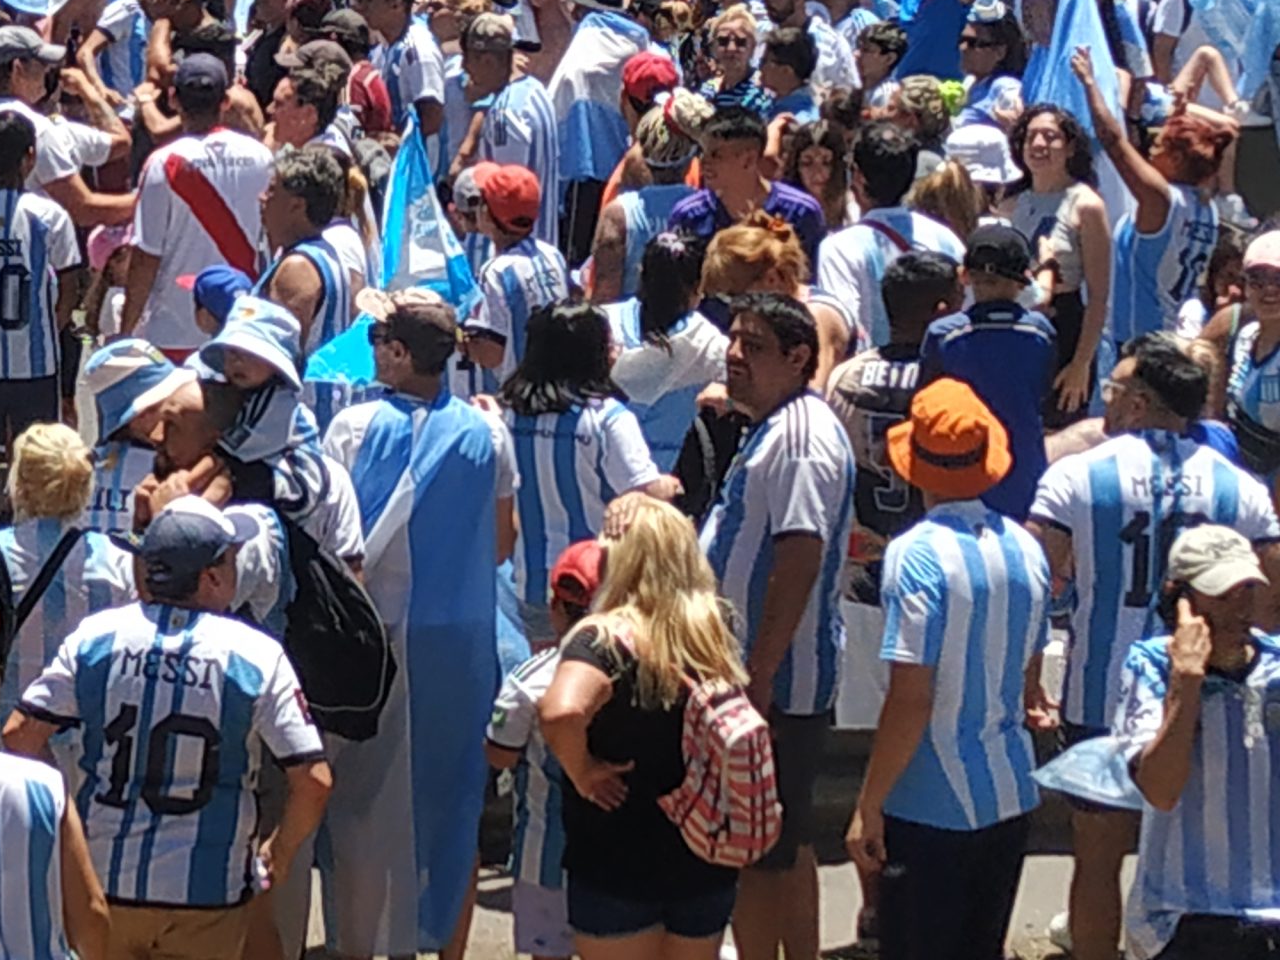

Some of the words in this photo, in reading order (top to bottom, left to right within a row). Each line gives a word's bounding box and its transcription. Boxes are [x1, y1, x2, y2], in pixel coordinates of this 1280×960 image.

[1130, 474, 1203, 496] MESSI
[121, 646, 219, 690] MESSI
[94, 702, 223, 815] 10
